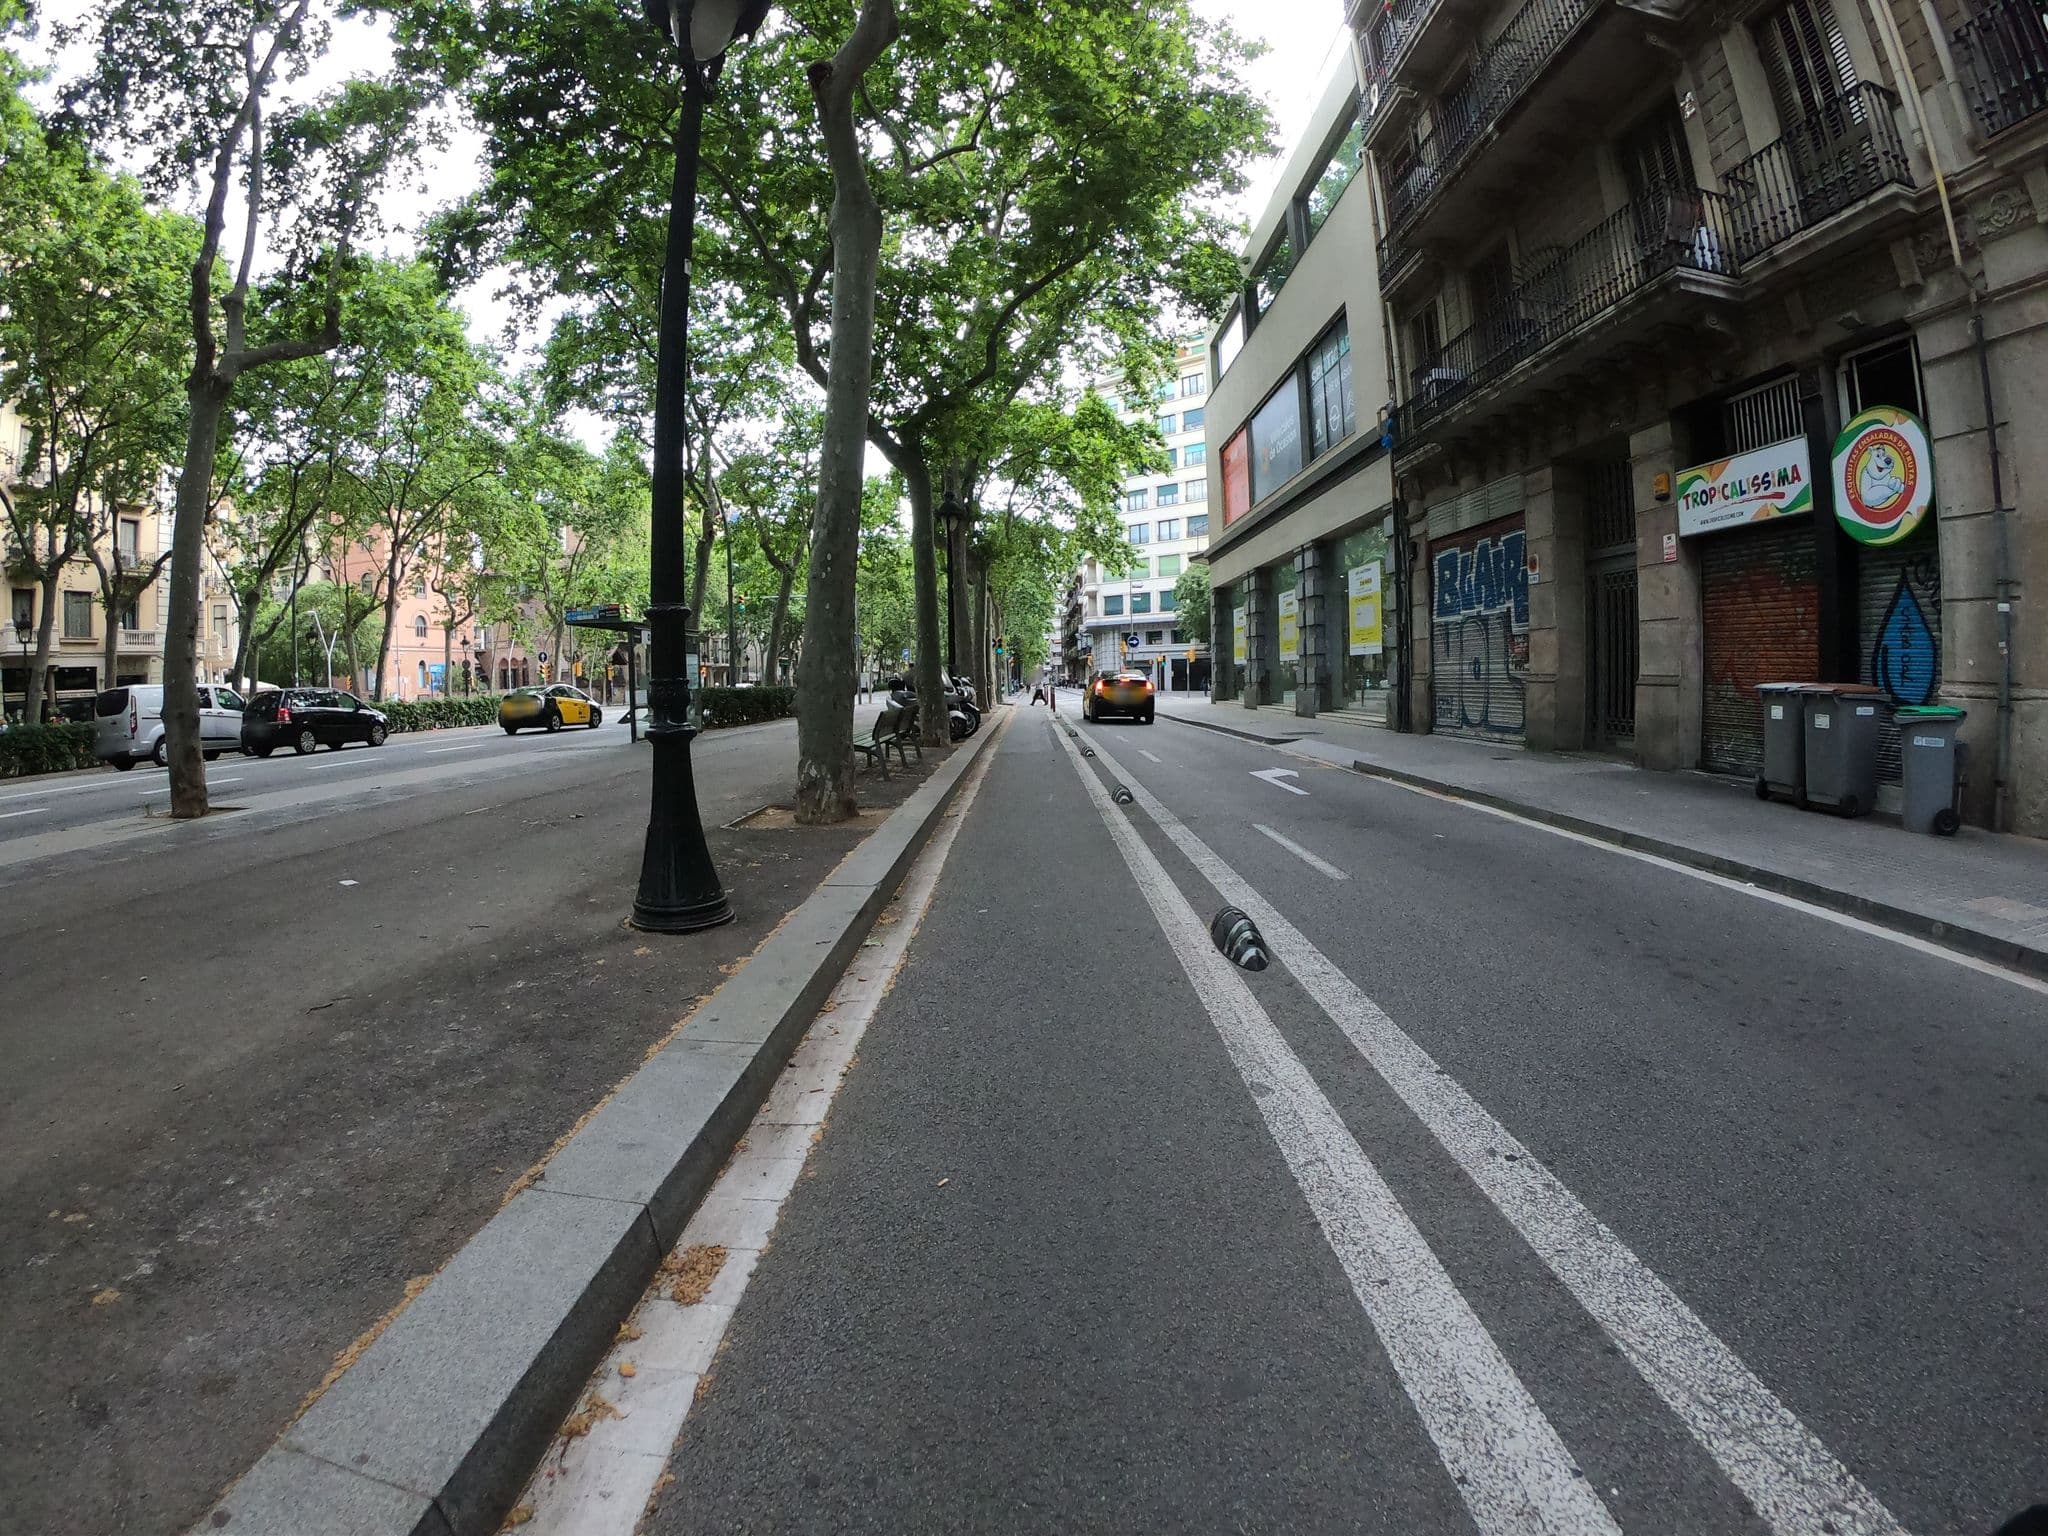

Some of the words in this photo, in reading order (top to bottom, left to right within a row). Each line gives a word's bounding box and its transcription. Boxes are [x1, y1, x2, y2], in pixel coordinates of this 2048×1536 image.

[1683, 463, 1801, 511] TROPICALISSIMA
[1847, 450, 1859, 499] EXQUISITAS
[1859, 432, 1898, 450] ENSALADAS
[1897, 440, 1906, 450] DE
[1904, 449, 1914, 486] FRUTAS
